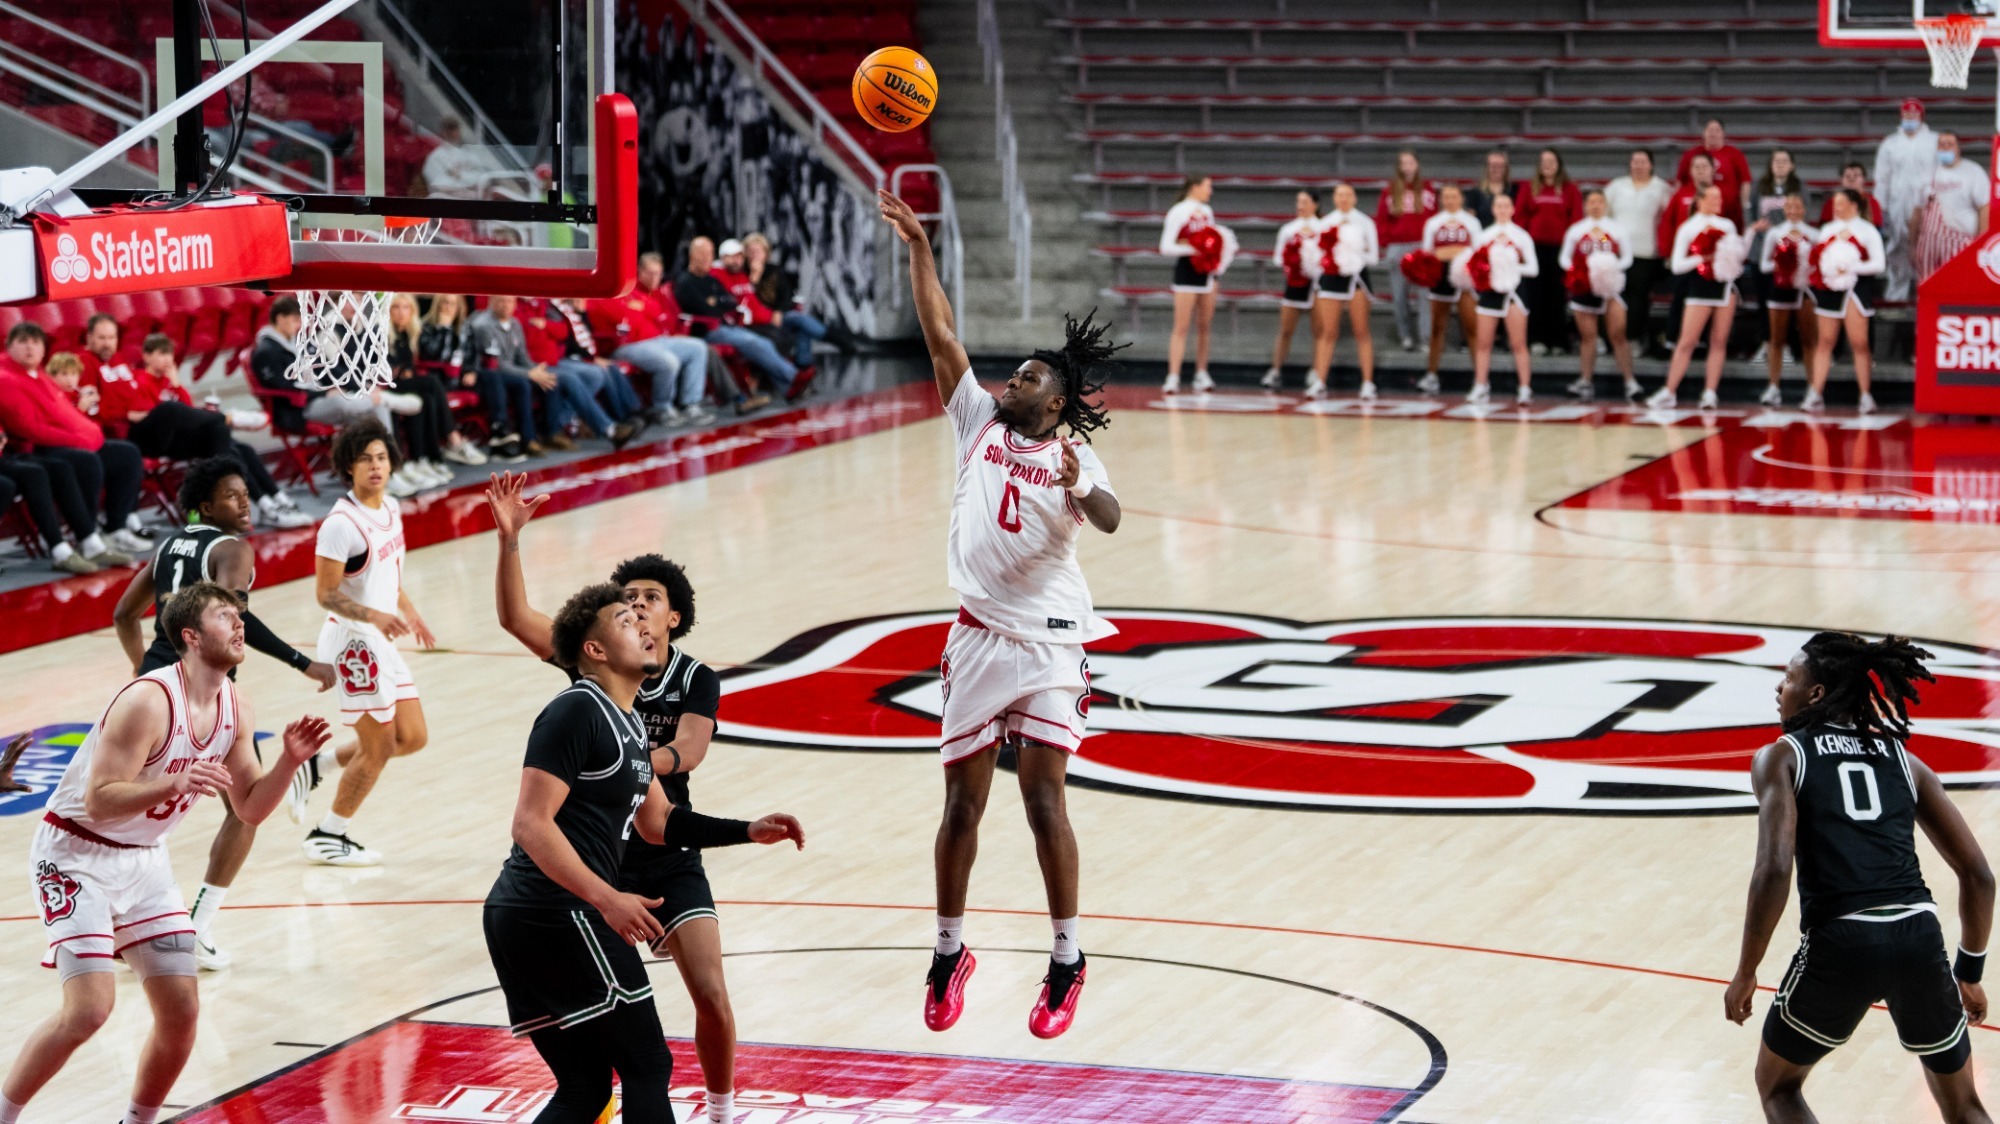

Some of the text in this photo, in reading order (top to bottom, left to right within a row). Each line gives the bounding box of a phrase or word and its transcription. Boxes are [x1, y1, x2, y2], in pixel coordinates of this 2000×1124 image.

[884, 71, 931, 109] Wilson
[875, 101, 913, 125] NCAA
[998, 480, 1022, 534] 0
[172, 559, 184, 594] 1
[1837, 761, 1882, 821] 0
